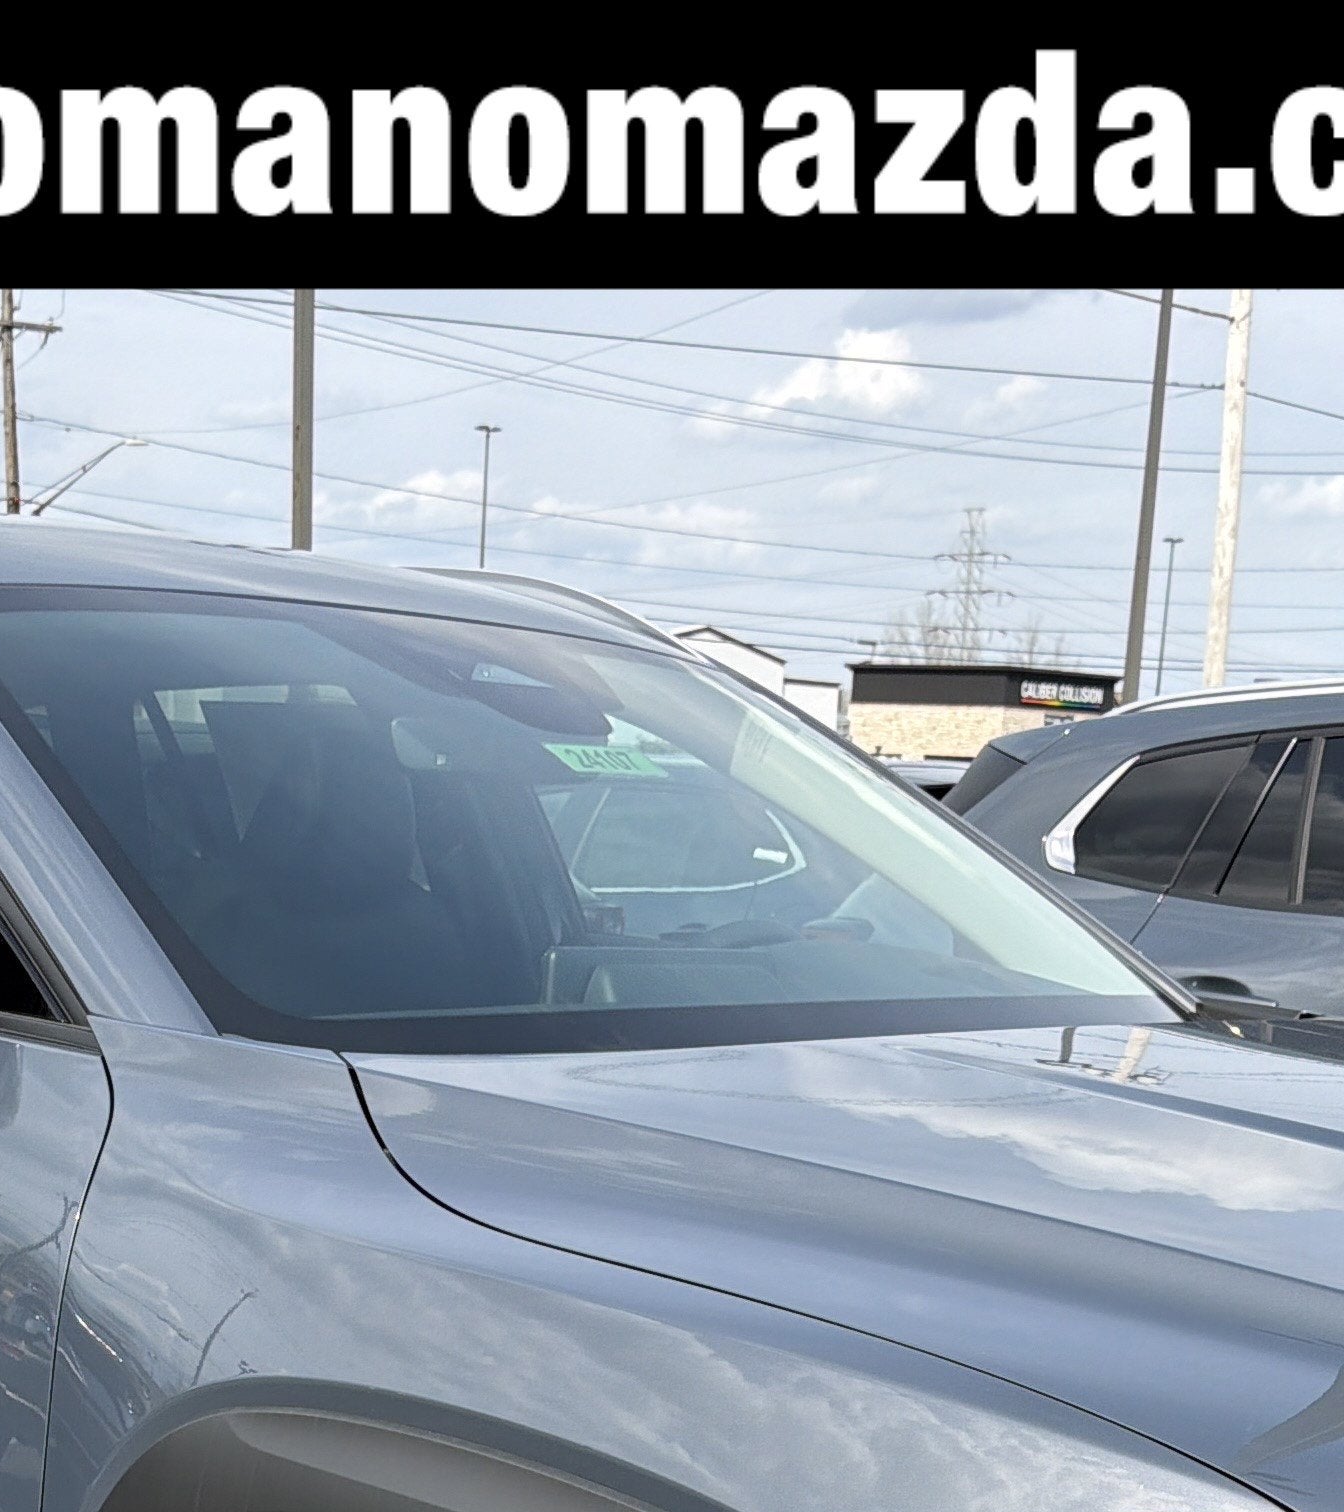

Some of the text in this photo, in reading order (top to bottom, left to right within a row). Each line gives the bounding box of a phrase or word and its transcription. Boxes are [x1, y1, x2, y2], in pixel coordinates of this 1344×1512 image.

[1020, 680, 1104, 704] CALIBER COLLISION
[564, 748, 640, 771] 24107
